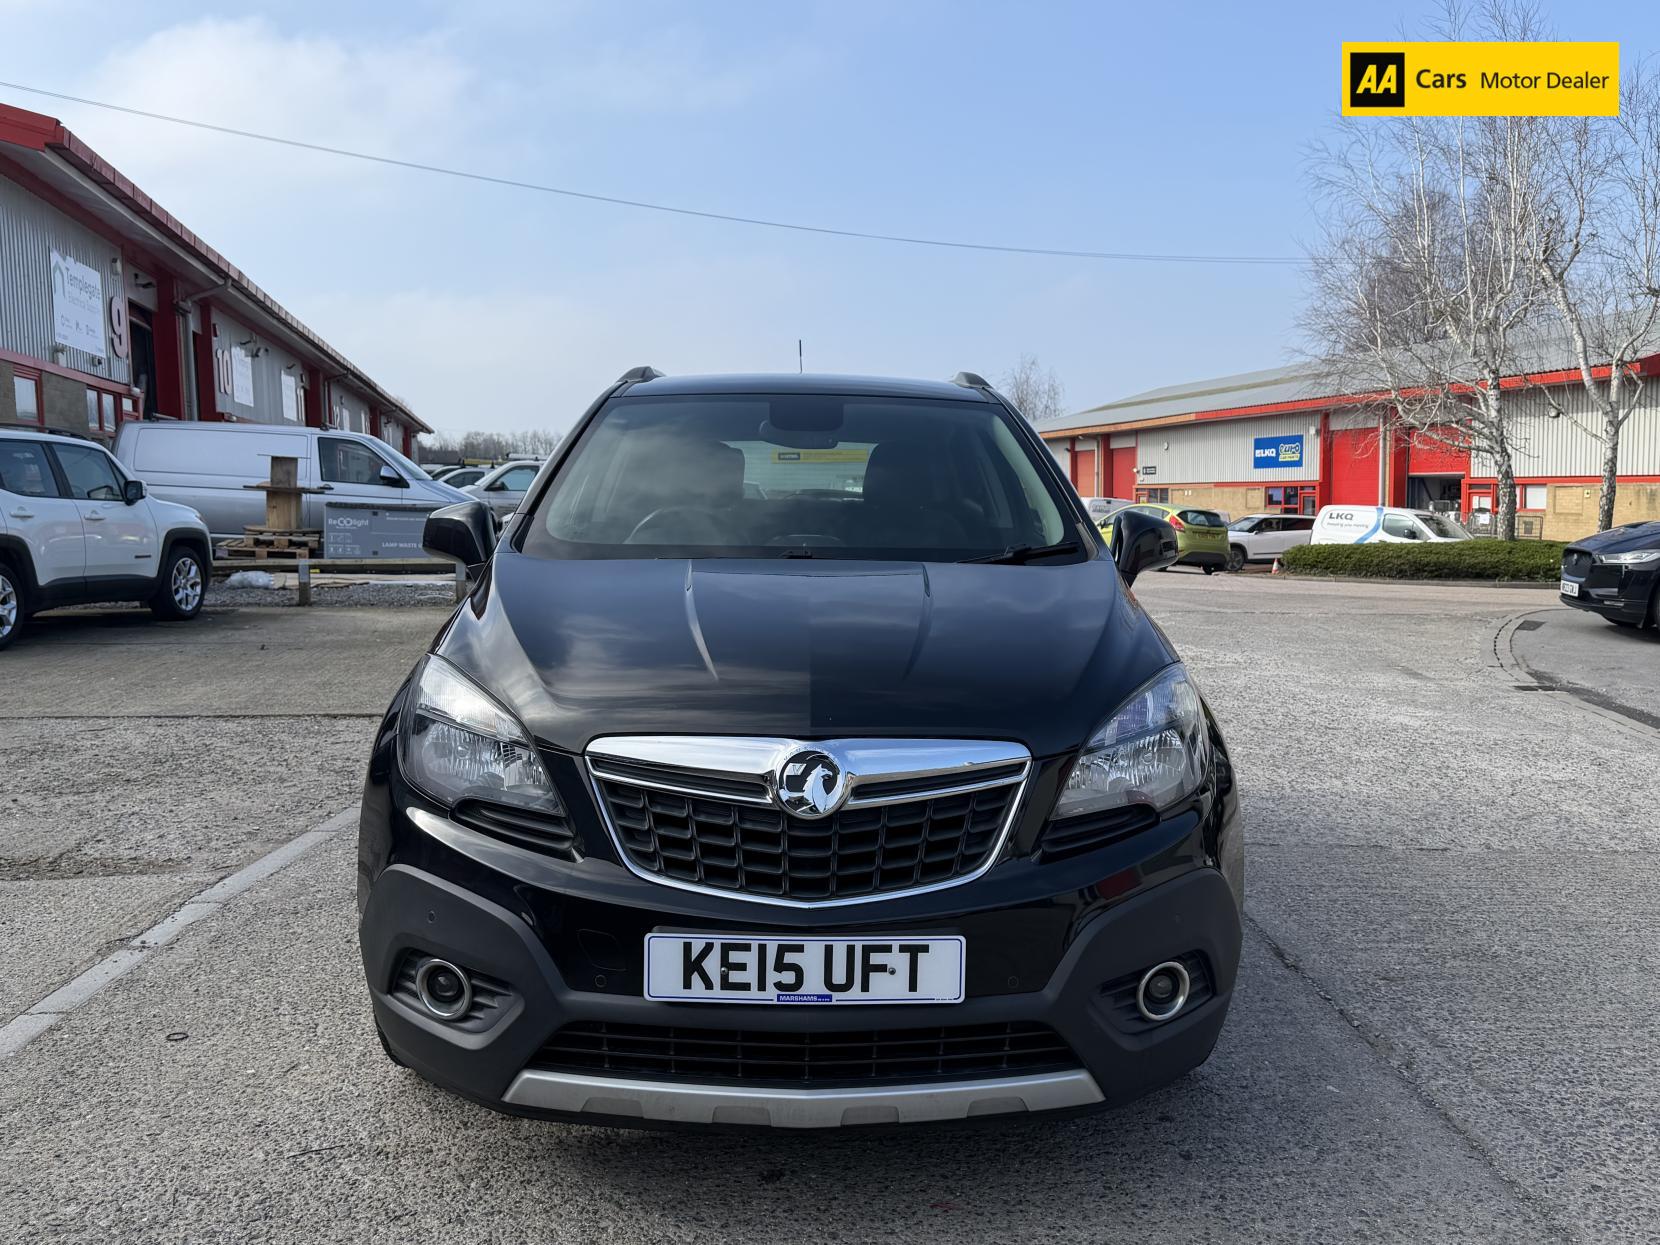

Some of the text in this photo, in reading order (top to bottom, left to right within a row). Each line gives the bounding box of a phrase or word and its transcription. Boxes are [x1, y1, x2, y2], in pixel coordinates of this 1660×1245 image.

[65, 266, 101, 300] Templegate
[110, 295, 129, 359] 9
[216, 348, 232, 396] 10
[1329, 512, 1354, 520] LKQ
[682, 941, 930, 993] KE15 UFT
